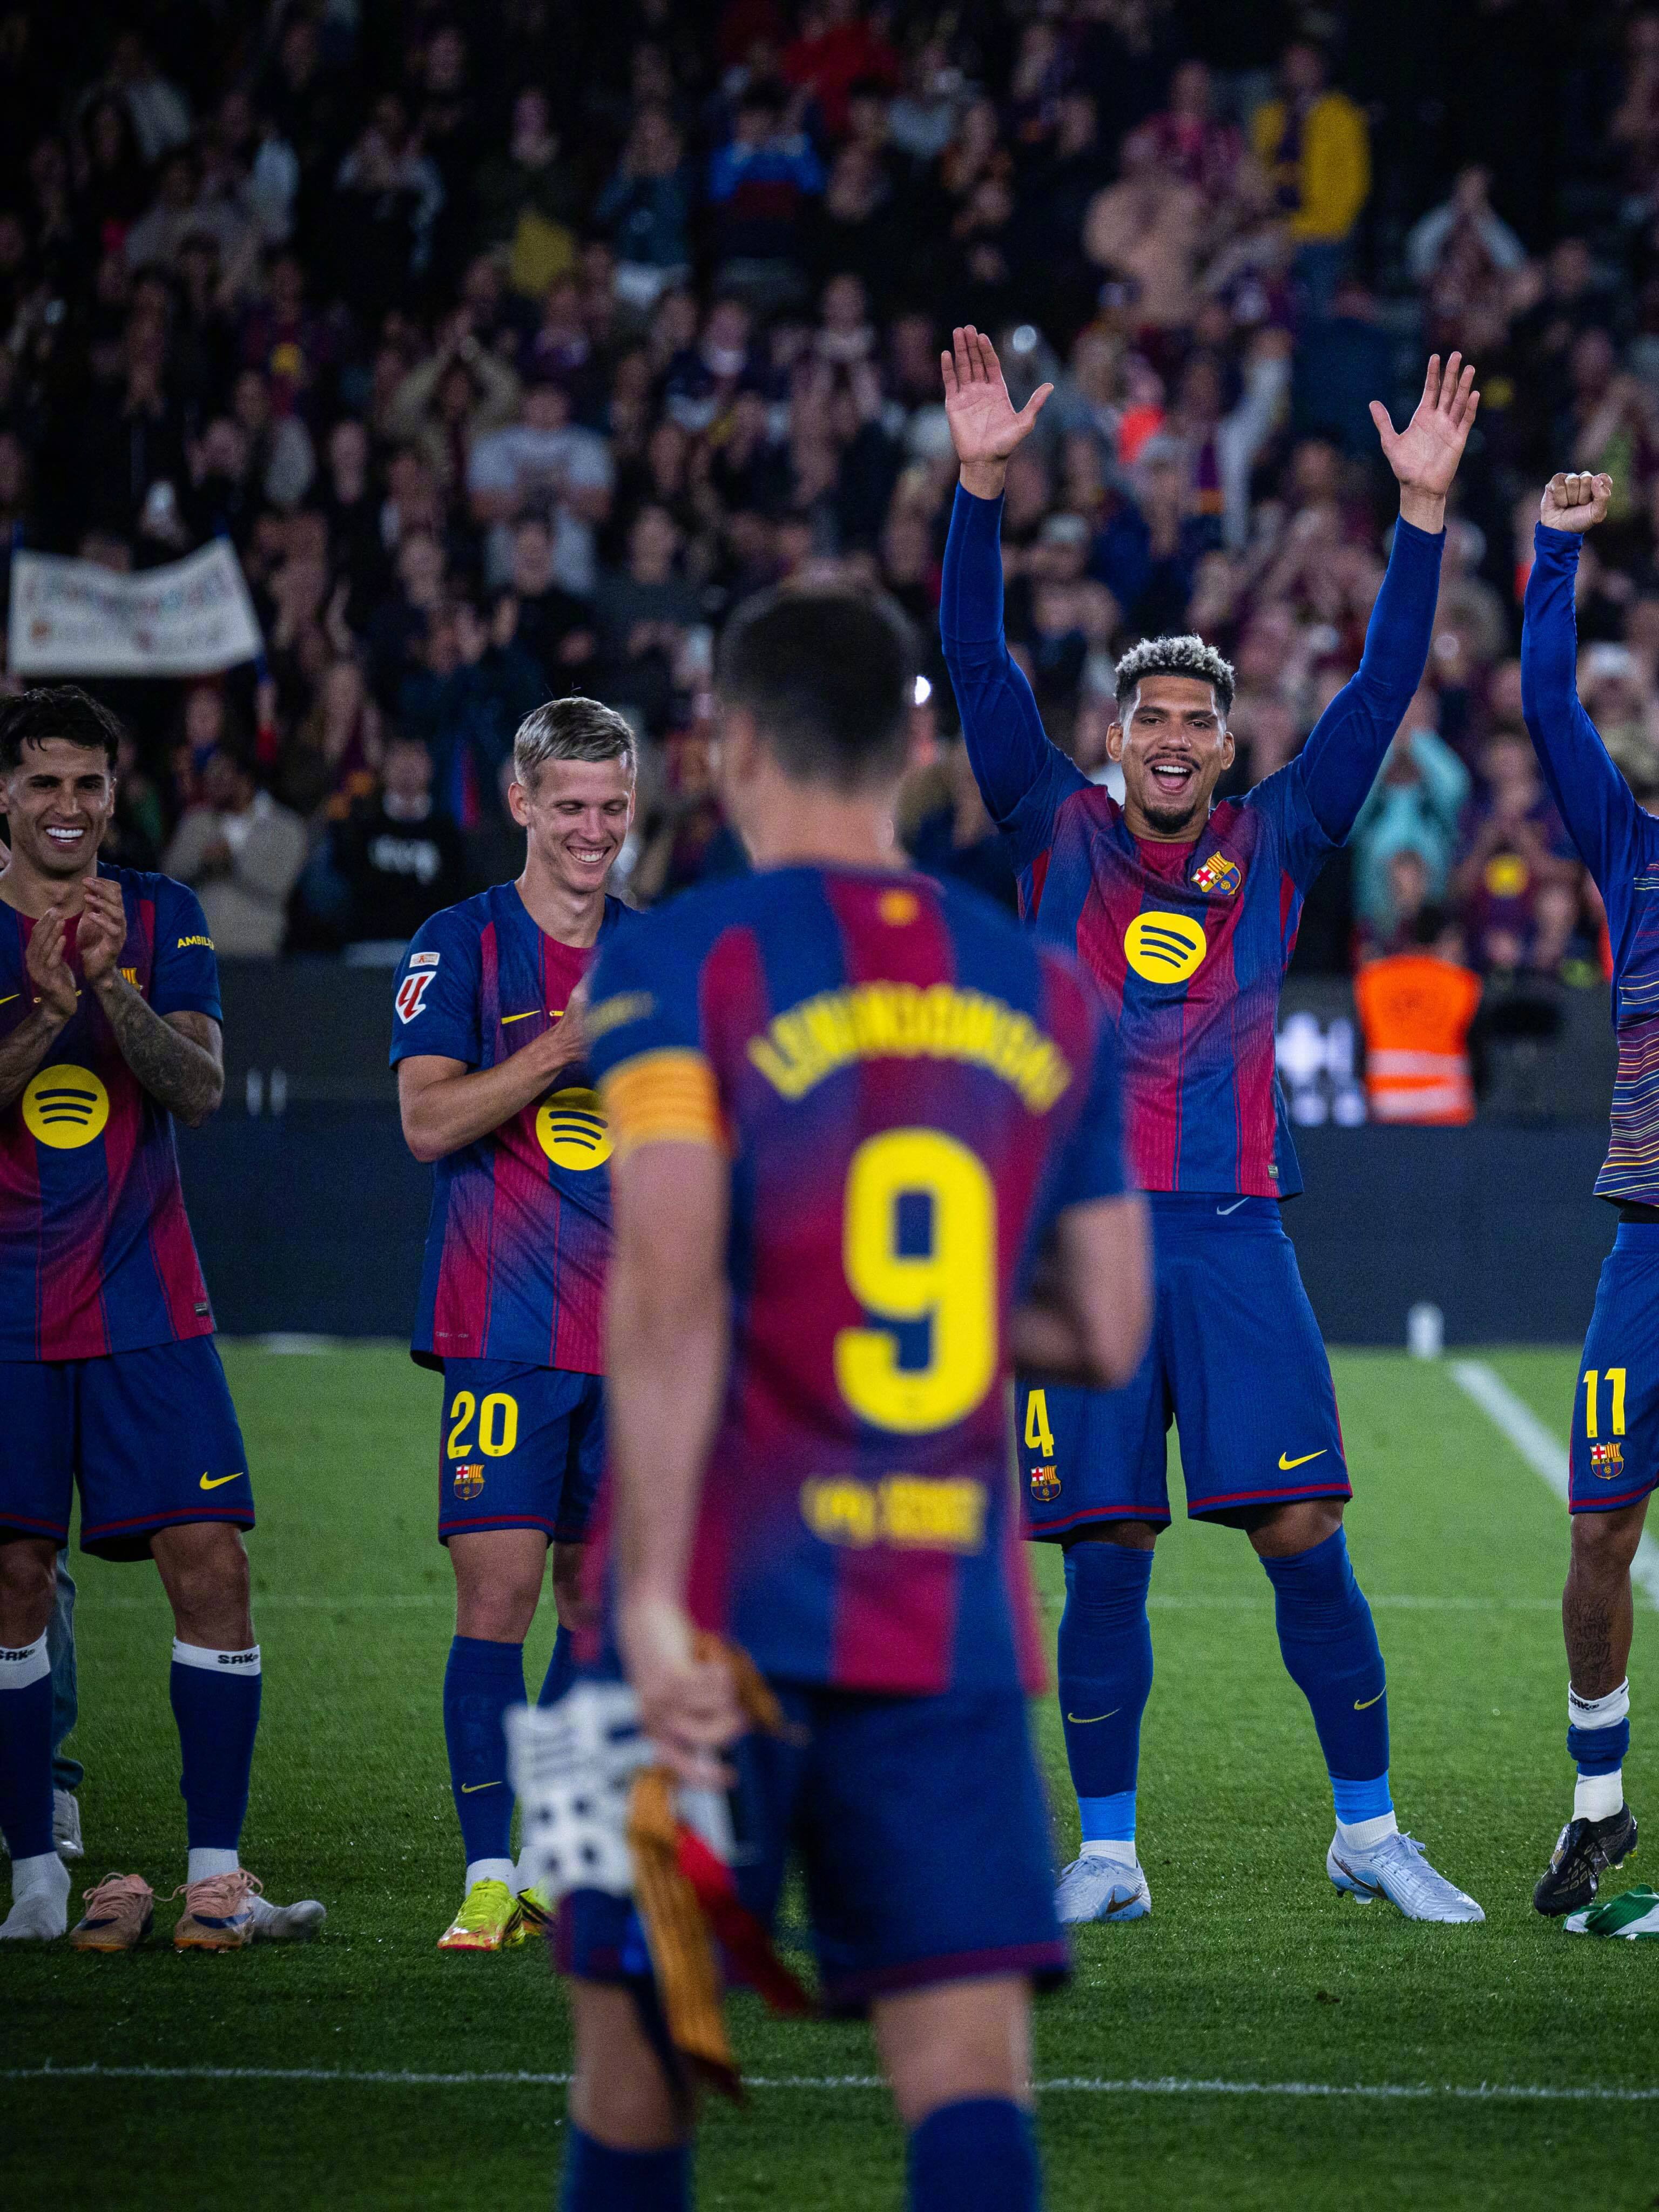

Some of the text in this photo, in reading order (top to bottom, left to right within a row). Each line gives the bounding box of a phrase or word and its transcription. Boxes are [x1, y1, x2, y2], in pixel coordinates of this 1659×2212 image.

[1210, 870, 1225, 885] FCB
[836, 1129, 996, 1434] 9
[447, 1391, 518, 1459] 20
[1024, 1389, 1054, 1457] 4
[1583, 1368, 1626, 1438] 11
